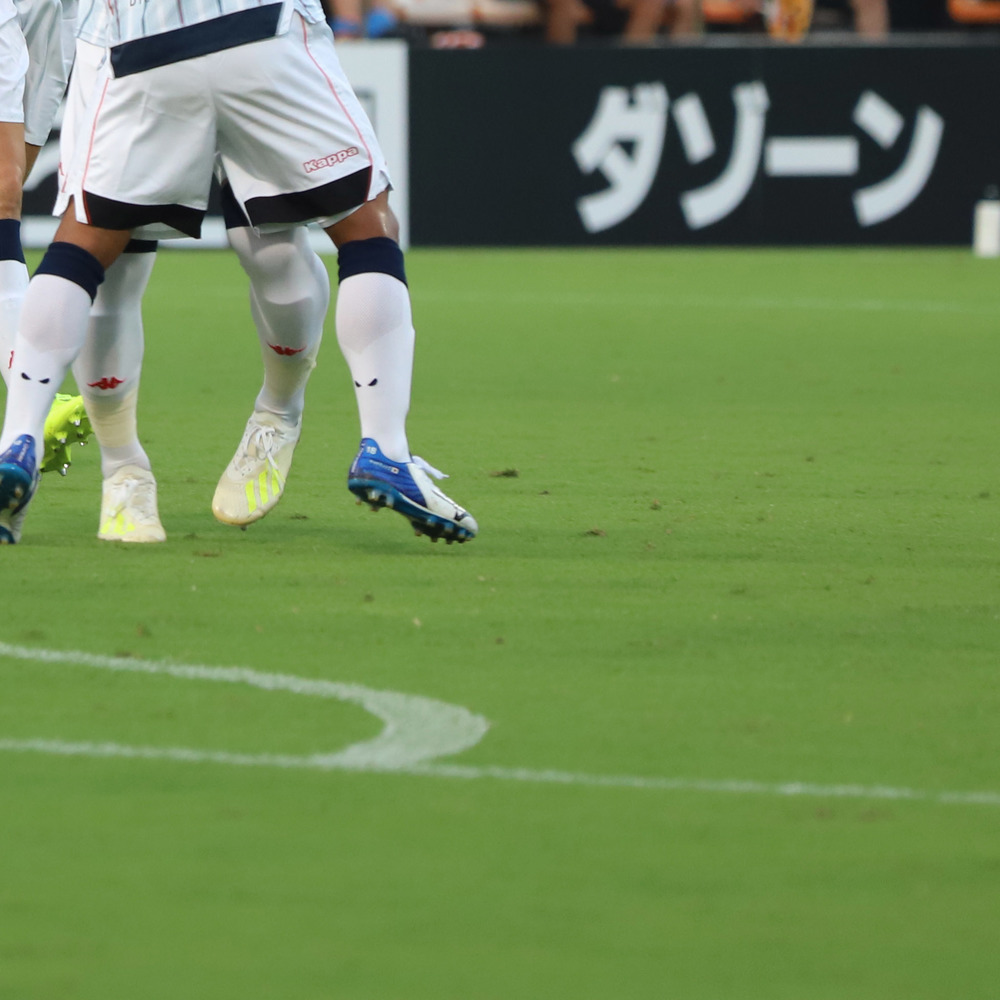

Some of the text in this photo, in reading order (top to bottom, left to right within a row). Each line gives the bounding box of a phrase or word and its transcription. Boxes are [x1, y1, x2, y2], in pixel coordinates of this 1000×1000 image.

[303, 146, 359, 173] Kappa
[571, 80, 945, 234] ダゾーン
